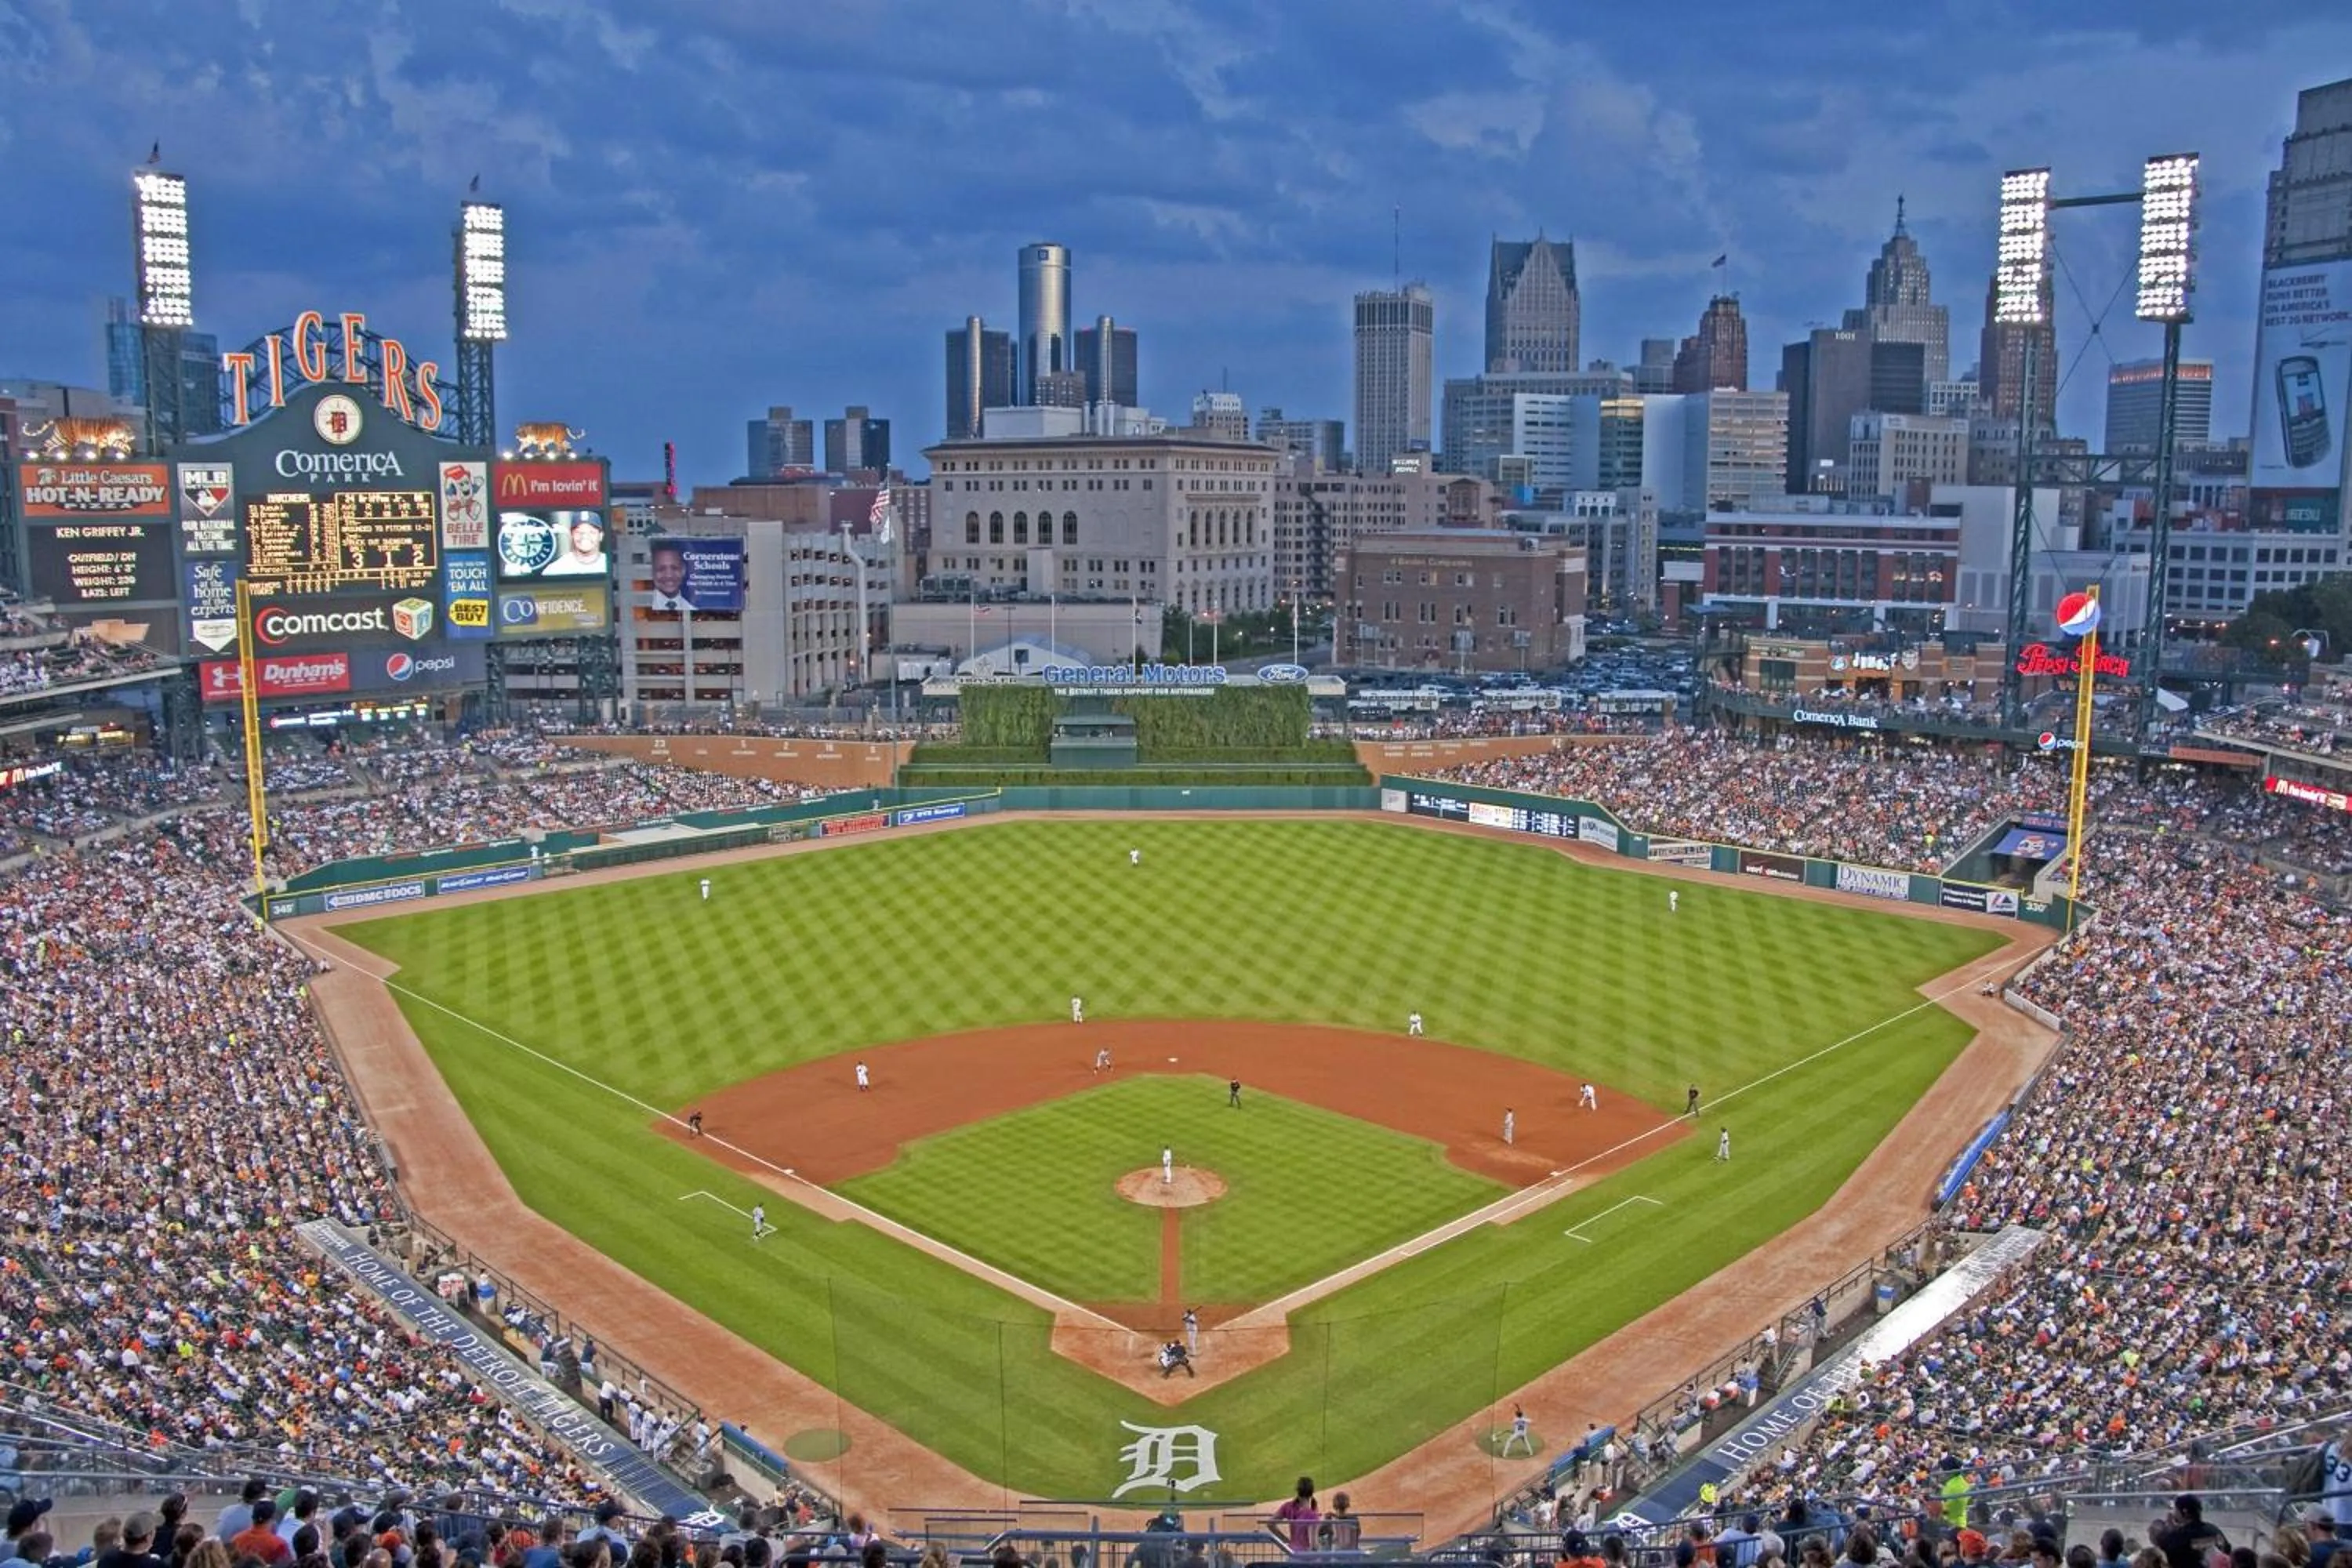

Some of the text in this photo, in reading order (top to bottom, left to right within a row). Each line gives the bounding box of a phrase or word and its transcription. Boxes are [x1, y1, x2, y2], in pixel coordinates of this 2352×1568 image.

[2267, 275, 2327, 289] BLACKBERRY
[2293, 289, 2328, 299] BETTER
[223, 310, 441, 430] TIGERS
[61, 470, 153, 485] Little Caesars
[184, 471, 227, 484] MLB
[309, 473, 371, 484] PARK
[531, 479, 598, 492] I'm lovin' it
[26, 486, 165, 503] HOT-N-READY
[56, 526, 144, 538] KEN GRIFFEY JR.
[447, 522, 484, 533] BELLE
[452, 535, 479, 545] TIRE
[352, 550, 424, 569] 3 1 2
[194, 564, 223, 580] Safe
[449, 569, 488, 579] TOUCH
[110, 587, 129, 597] LEFT
[193, 584, 232, 598] home
[469, 580, 488, 591] ALL
[191, 604, 237, 619] experts
[454, 604, 486, 613] BEST
[456, 613, 484, 622] BUY
[264, 659, 346, 681] Dunham's
[416, 655, 455, 674] pepsi
[1042, 663, 1227, 684] General Motors
[1267, 667, 1298, 681] Ford
[1848, 715, 1878, 728] Bank
[1840, 863, 1907, 889] DYNAMIC
[344, 1252, 615, 1457] HOME OF THE DETROIT TIGERS
[1718, 1410, 1798, 1462] HOME
[1791, 1385, 1826, 1411] OF
